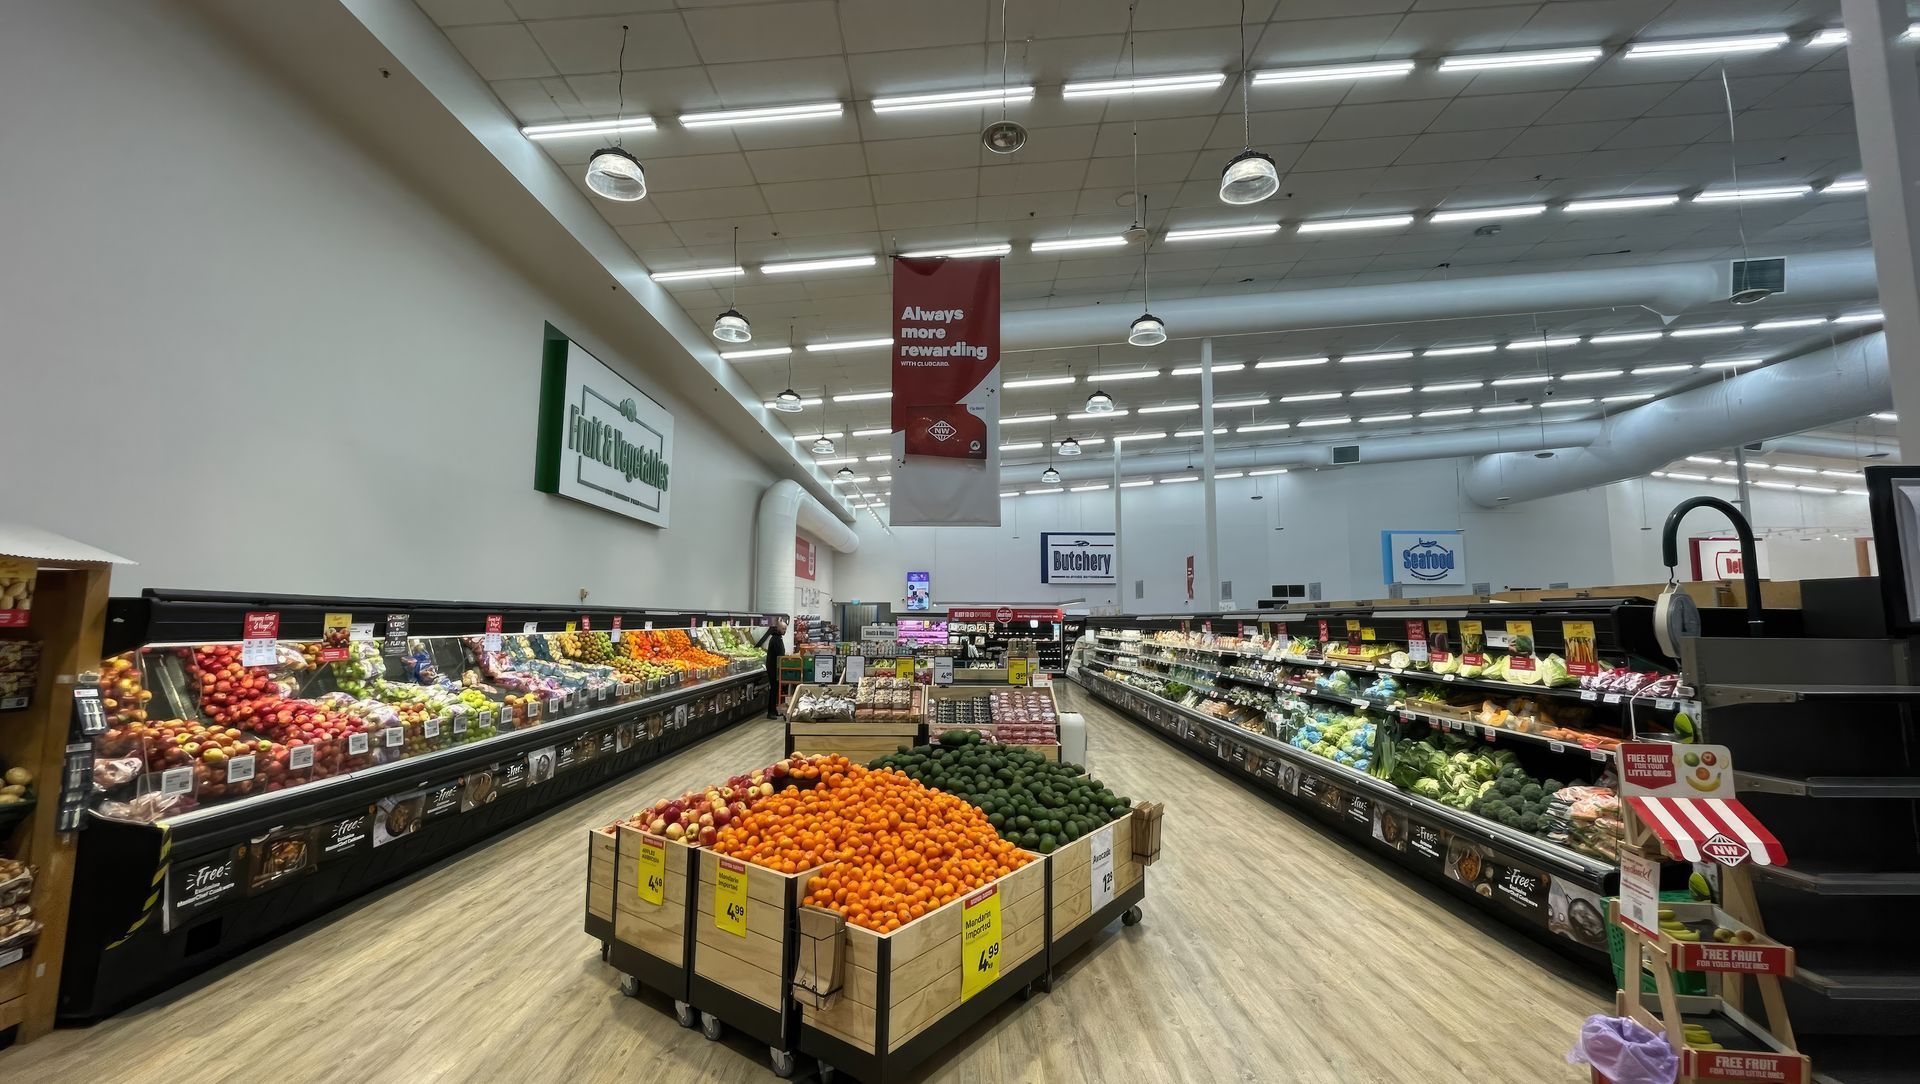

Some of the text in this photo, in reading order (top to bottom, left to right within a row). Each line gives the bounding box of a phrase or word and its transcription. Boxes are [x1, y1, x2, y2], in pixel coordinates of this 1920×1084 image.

[901, 306, 964, 323] Always
[901, 327, 946, 339] more
[901, 341, 987, 360] rewarding
[568, 404, 669, 492] Fruit & Vegetables
[1053, 550, 1111, 574] Butchery
[1403, 549, 1455, 569] Seafood
[1627, 754, 1669, 763] FREE FRUIT
[1712, 845, 1738, 855] NW
[196, 866, 224, 886] Free
[1510, 868, 1530, 887] Free
[965, 910, 991, 929] Mandarin
[965, 919, 991, 940] Imported
[1702, 948, 1763, 962] FREE FRUIT
[1709, 1067, 1724, 1075] FOR
[1725, 1068, 1745, 1076] YOUR
[1745, 1069, 1767, 1077] LITTLE
[1715, 1055, 1778, 1071] FREE FRUIT
